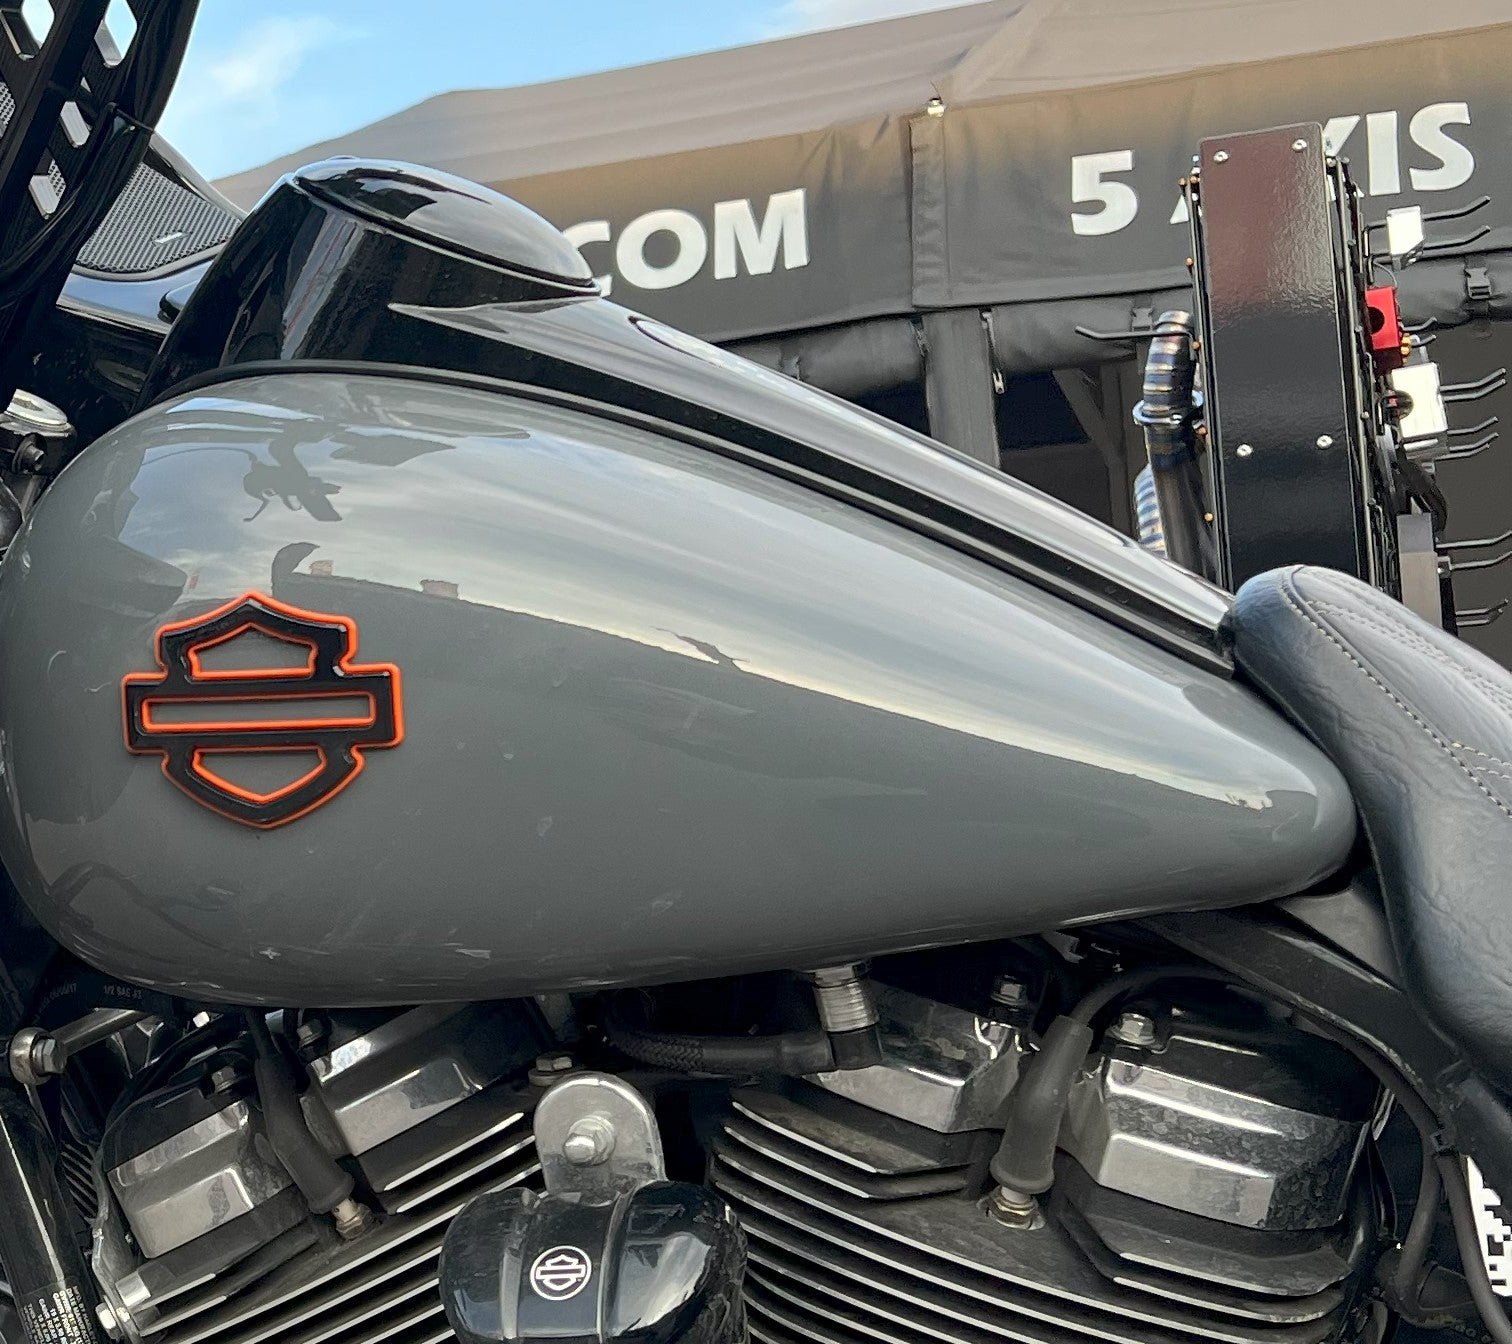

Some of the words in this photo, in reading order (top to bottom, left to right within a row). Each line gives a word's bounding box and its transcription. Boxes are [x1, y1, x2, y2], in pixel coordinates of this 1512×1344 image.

[1070, 149, 1139, 236] 5
[1169, 102, 1477, 225] IS
[563, 188, 809, 297] COM
